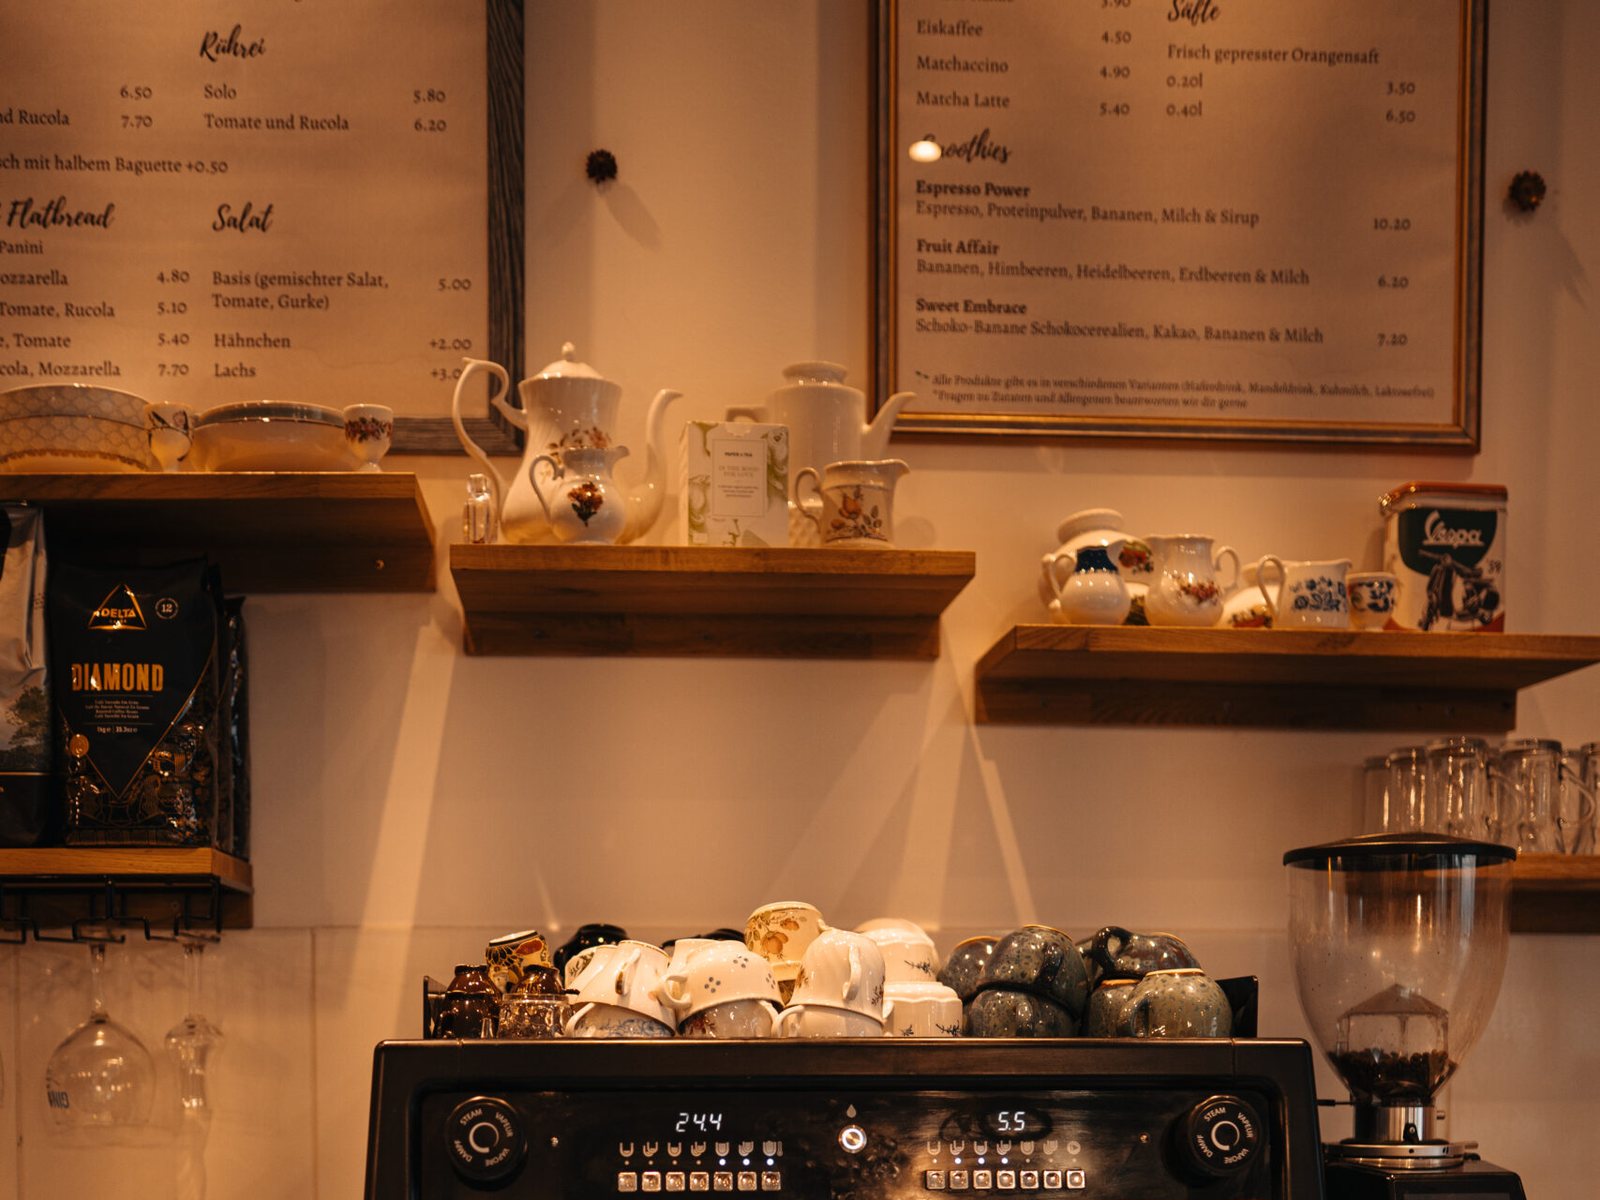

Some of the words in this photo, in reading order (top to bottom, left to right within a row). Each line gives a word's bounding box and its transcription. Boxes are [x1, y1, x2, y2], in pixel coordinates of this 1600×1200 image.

[916, 19, 983, 37] Eiskaffee
[199, 24, 266, 62] Rührei
[1101, 31, 1132, 44] 4.50
[916, 54, 1009, 73] Matchaccino
[1168, 44, 1211, 60] Frisch
[1214, 48, 1288, 64] gepresster
[1291, 47, 1380, 67] Orangensaft
[1100, 66, 1130, 79] 4.90
[1166, 73, 1203, 89] 0.20l
[119, 85, 153, 100] 6.50
[204, 83, 237, 100] Solo
[413, 89, 446, 104] 5.80
[916, 91, 970, 107] Matcha
[974, 93, 1010, 108] Latte
[18, 109, 70, 125] Rucola
[1100, 103, 1130, 116] 5.40
[1166, 102, 1202, 117] 0.40l
[121, 115, 153, 128] 7.70
[204, 113, 261, 130] Tomate
[265, 114, 295, 130] und
[300, 114, 350, 131] Rucola
[414, 118, 447, 132] 6.20
[24, 154, 50, 171] mit
[54, 154, 110, 171] halbem
[115, 157, 182, 175] Baguette
[186, 161, 229, 175] +0.50
[916, 180, 981, 197] Espresso
[984, 182, 1031, 198] Power
[7, 196, 116, 229] Flatbread
[212, 202, 274, 233] Salat
[916, 200, 984, 218] Espresso,
[987, 202, 1087, 222] Proteinpulver,
[1091, 206, 1158, 224] Bananen,
[1161, 207, 1201, 223] Milch
[1204, 209, 1217, 223] &
[1220, 208, 1260, 228] Sirup
[917, 239, 952, 254] Fruit
[956, 240, 1000, 255] Affair
[157, 269, 190, 284] 4.80
[212, 271, 251, 286] Basis
[254, 271, 343, 289] (gemischter
[346, 272, 389, 289] Salat,
[917, 259, 985, 277] Bananen,
[988, 261, 1073, 280] Himbeeren,
[1077, 264, 1176, 283] Heidelbeeren,
[1179, 267, 1251, 283] Erdbeeren
[1255, 268, 1267, 284] &
[1270, 269, 1310, 285] Milch
[437, 277, 472, 292] 5.00
[64, 302, 116, 318] Rucola
[157, 302, 188, 315] 5.10
[211, 294, 274, 310] Tomate,
[277, 294, 330, 312] Gurke)
[916, 298, 960, 313] Sweet
[963, 299, 1027, 315] Embrace
[157, 333, 190, 347] 5.40
[916, 318, 1027, 336] Schoko-Banane
[1153, 323, 1199, 342] Kakao,
[1204, 325, 1266, 343] Bananen
[1269, 327, 1281, 343] &
[1284, 327, 1324, 345] Milch
[12, 333, 71, 348] Tomate
[214, 333, 291, 348] Hähnchen
[429, 337, 472, 351] +2.00
[38, 361, 121, 377] Mozzarella
[158, 363, 190, 377] 7.70
[214, 363, 256, 378] Lachs
[1423, 510, 1485, 549] Vespa
[101, 608, 137, 618] DELTA
[161, 603, 173, 613] 12
[71, 663, 164, 691] DIAMOND
[460, 1108, 483, 1126] STEAM
[675, 1112, 723, 1132] 24.4
[997, 1111, 1026, 1131] 5.5
[1203, 1106, 1227, 1122] STEAM
[495, 1112, 514, 1138] VAPEUR
[1237, 1112, 1254, 1138] VAPEUR
[454, 1140, 473, 1162] DAMPF
[1196, 1134, 1214, 1158] DAMPF
[1223, 1148, 1250, 1165] VAPORE
